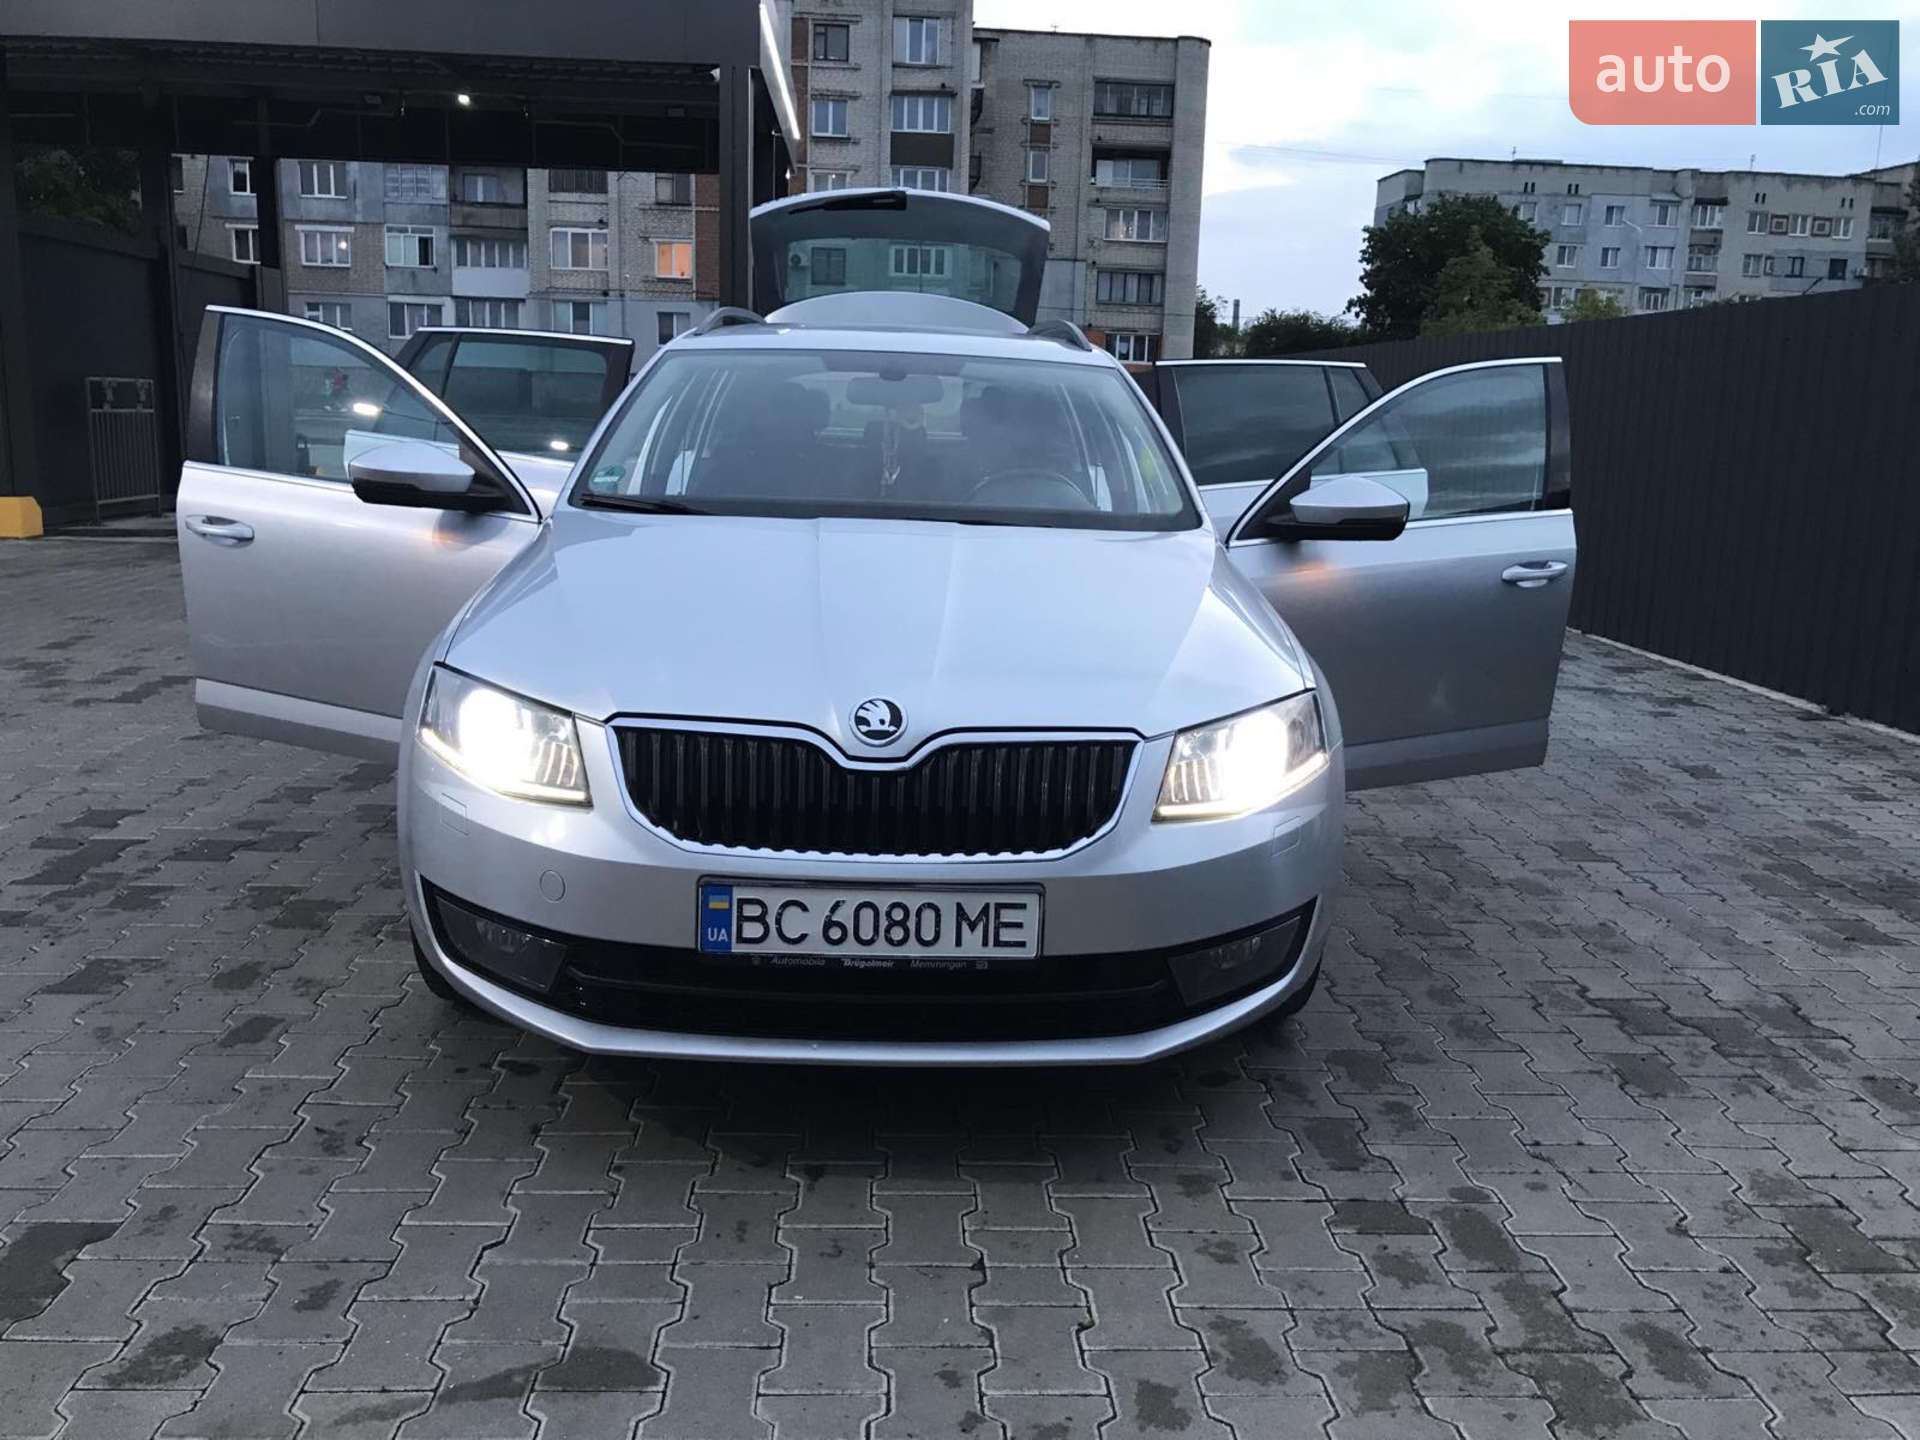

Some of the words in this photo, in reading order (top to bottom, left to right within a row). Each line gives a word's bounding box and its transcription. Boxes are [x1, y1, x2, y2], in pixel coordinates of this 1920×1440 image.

[707, 927, 728, 942] UA
[735, 897, 810, 946] BC
[821, 899, 942, 947] 6080
[955, 901, 1028, 948] ME
